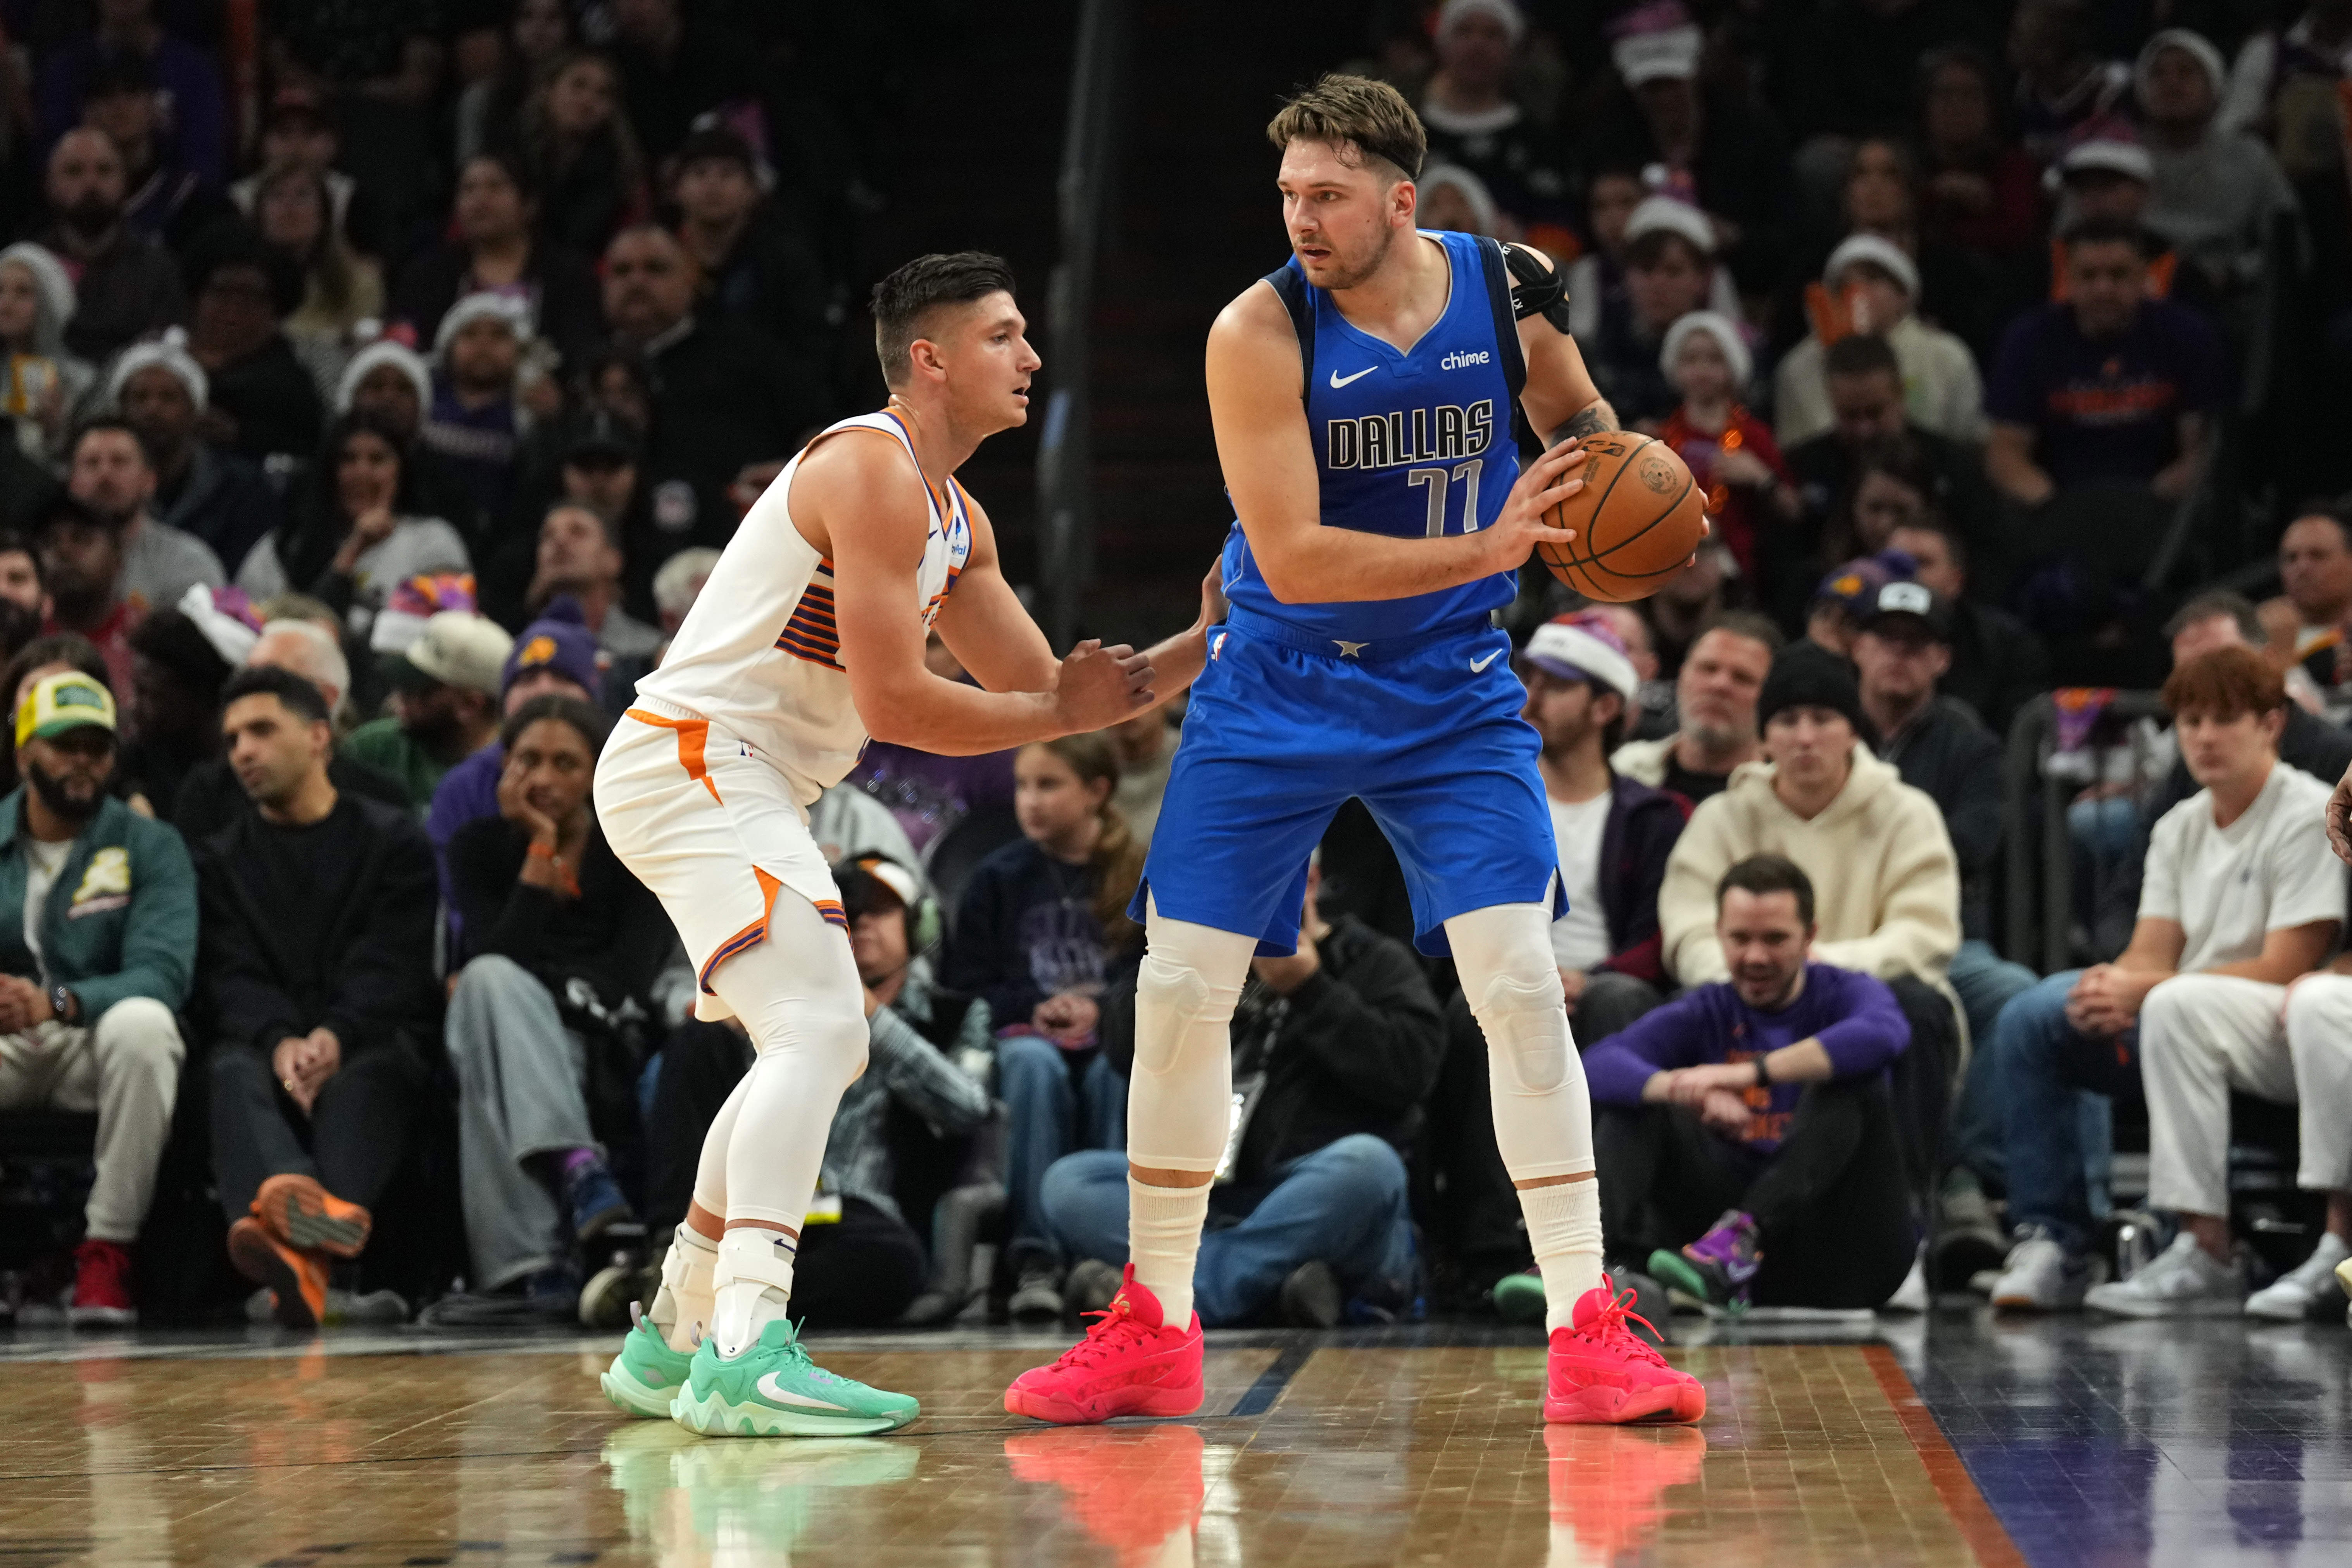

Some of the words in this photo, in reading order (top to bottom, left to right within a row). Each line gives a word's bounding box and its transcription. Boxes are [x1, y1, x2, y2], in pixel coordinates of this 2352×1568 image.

[1440, 350, 1490, 371] chime
[1328, 398, 1493, 469] DALLAS
[1407, 459, 1483, 538] 77
